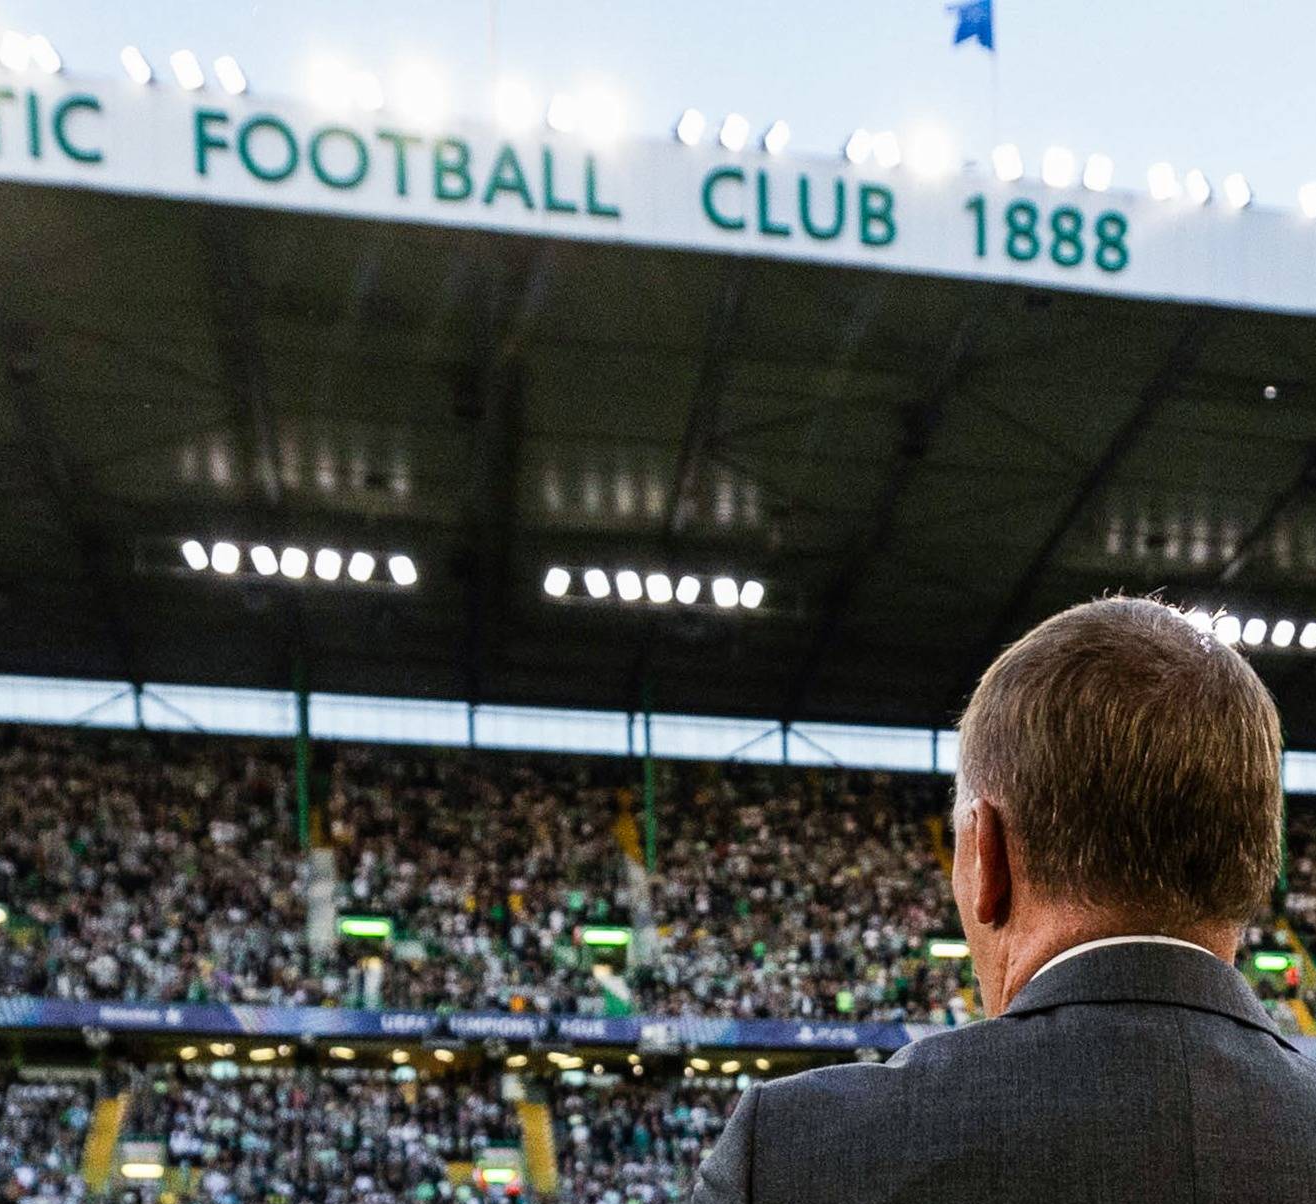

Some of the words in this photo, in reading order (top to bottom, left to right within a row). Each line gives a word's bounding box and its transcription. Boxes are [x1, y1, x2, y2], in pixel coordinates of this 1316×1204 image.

[192, 106, 621, 218] FOOTBALL
[700, 165, 899, 248] CLUB
[965, 192, 1129, 273] 1888
